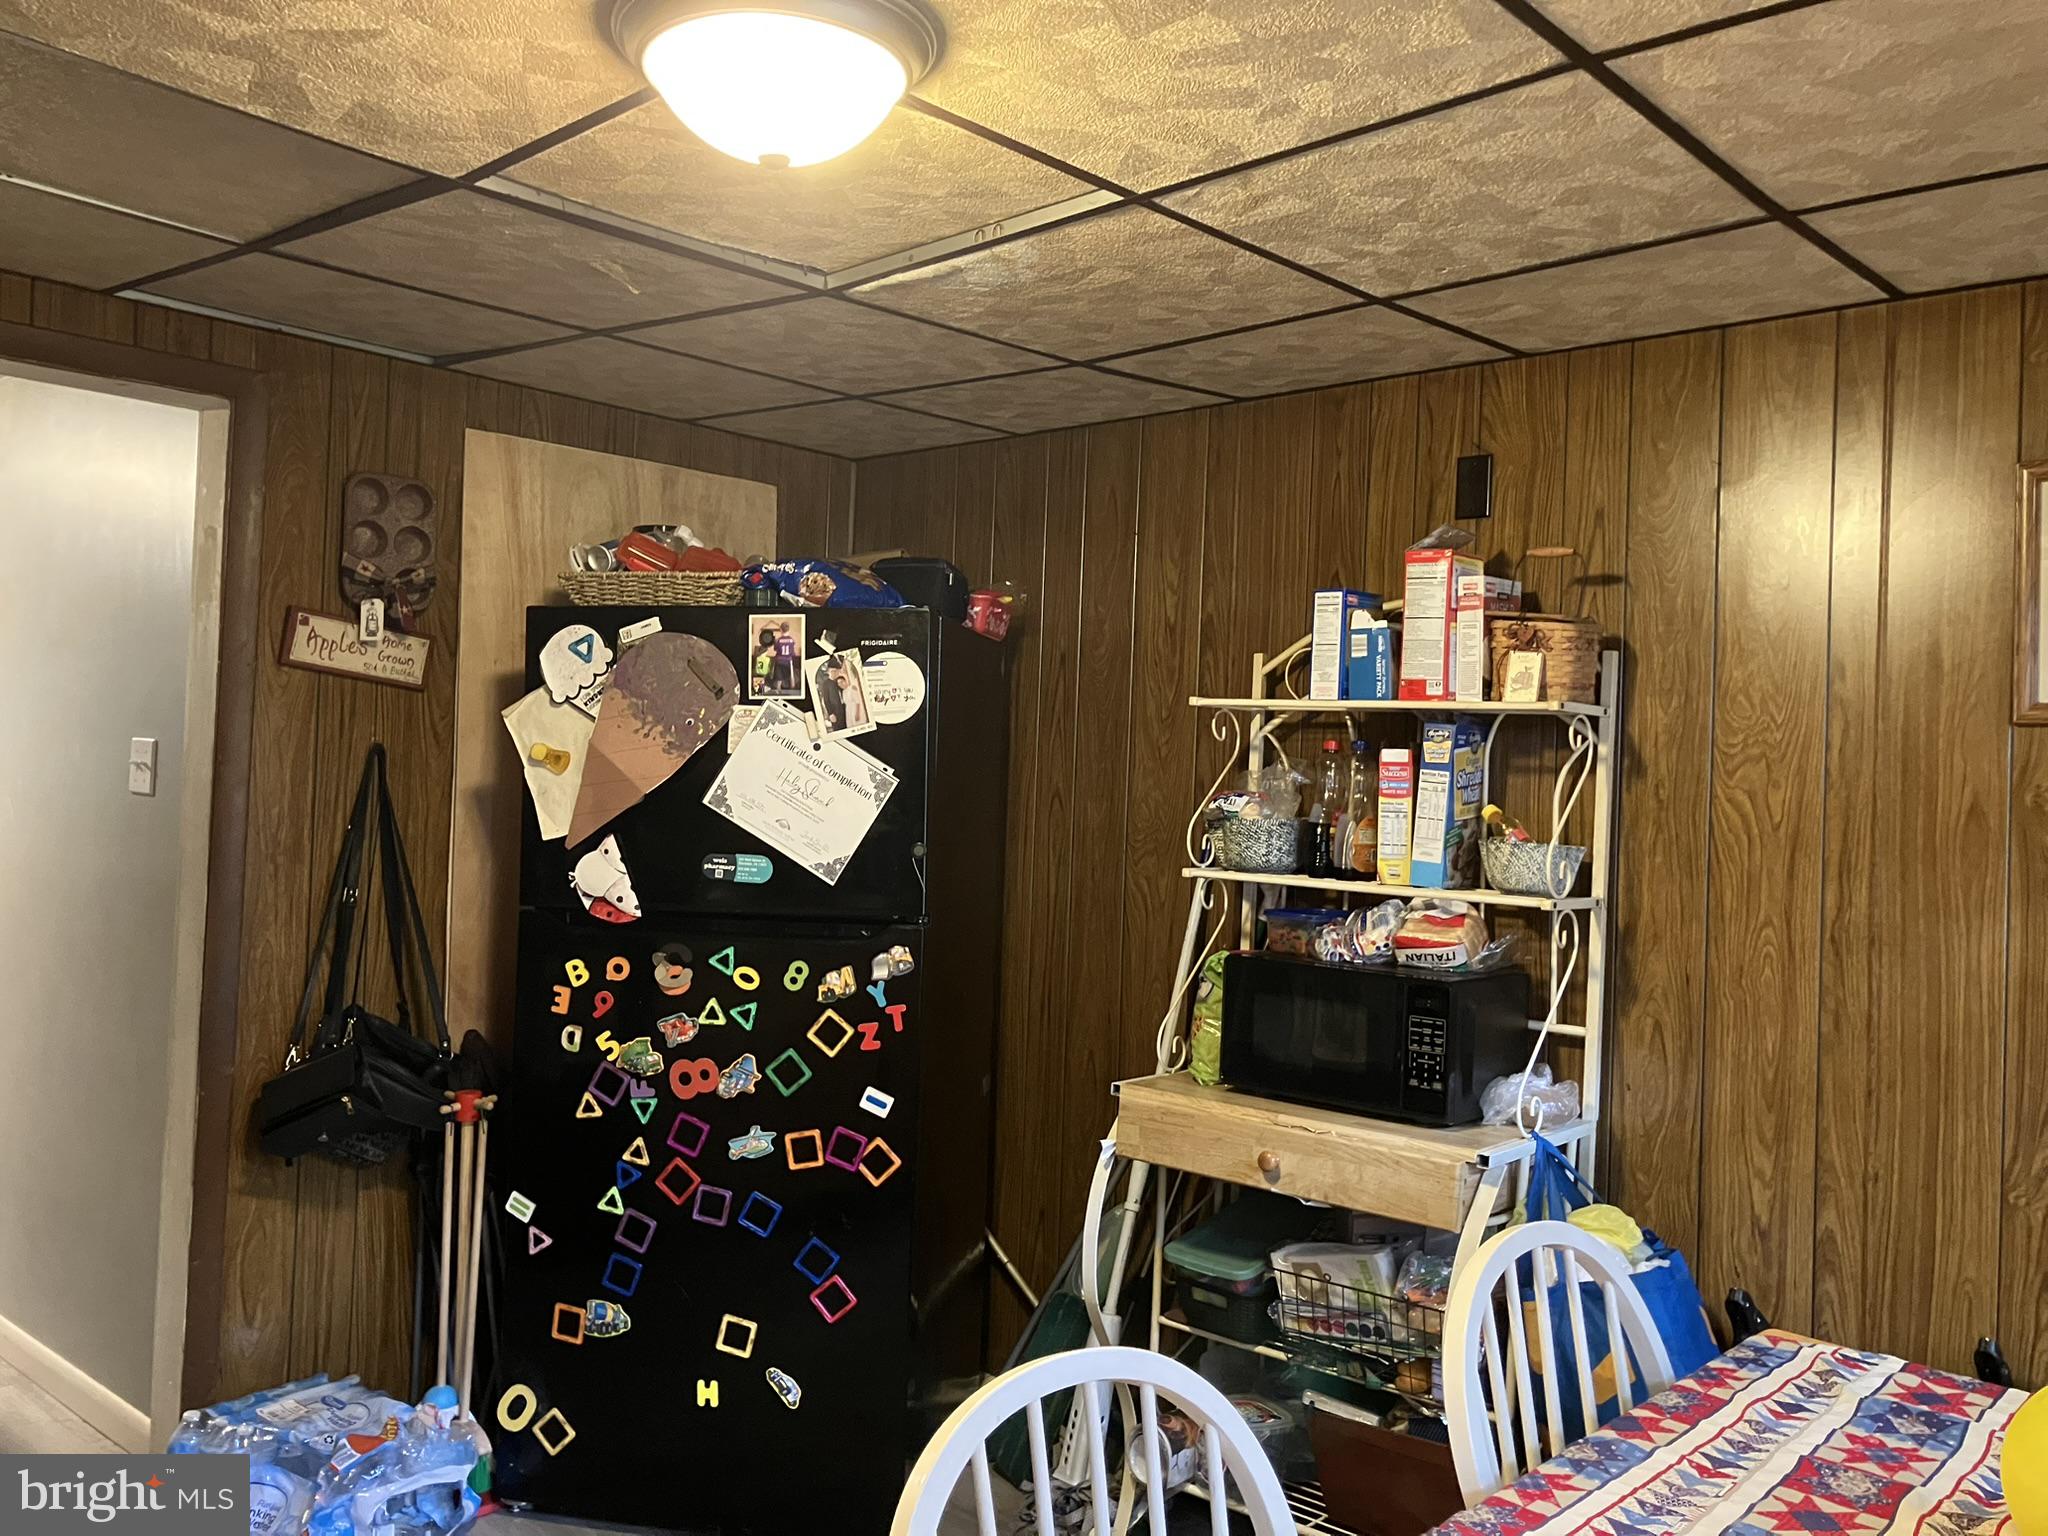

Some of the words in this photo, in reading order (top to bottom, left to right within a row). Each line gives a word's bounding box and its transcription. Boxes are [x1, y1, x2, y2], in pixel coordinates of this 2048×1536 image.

[382, 635, 413, 652] Home
[378, 650, 415, 668] Grown
[765, 728, 814, 763] Certificate
[813, 757, 826, 769] of
[824, 764, 873, 801] Completion
[1381, 768, 1408, 777] Success
[703, 863, 736, 872] pharmacy
[1405, 951, 1456, 962] ITALIAN
[564, 958, 590, 988] B
[783, 960, 810, 992] 8
[865, 980, 887, 1008] Y
[884, 1004, 907, 1033] T
[857, 1021, 882, 1051] Z
[696, 1378, 719, 1408] H
